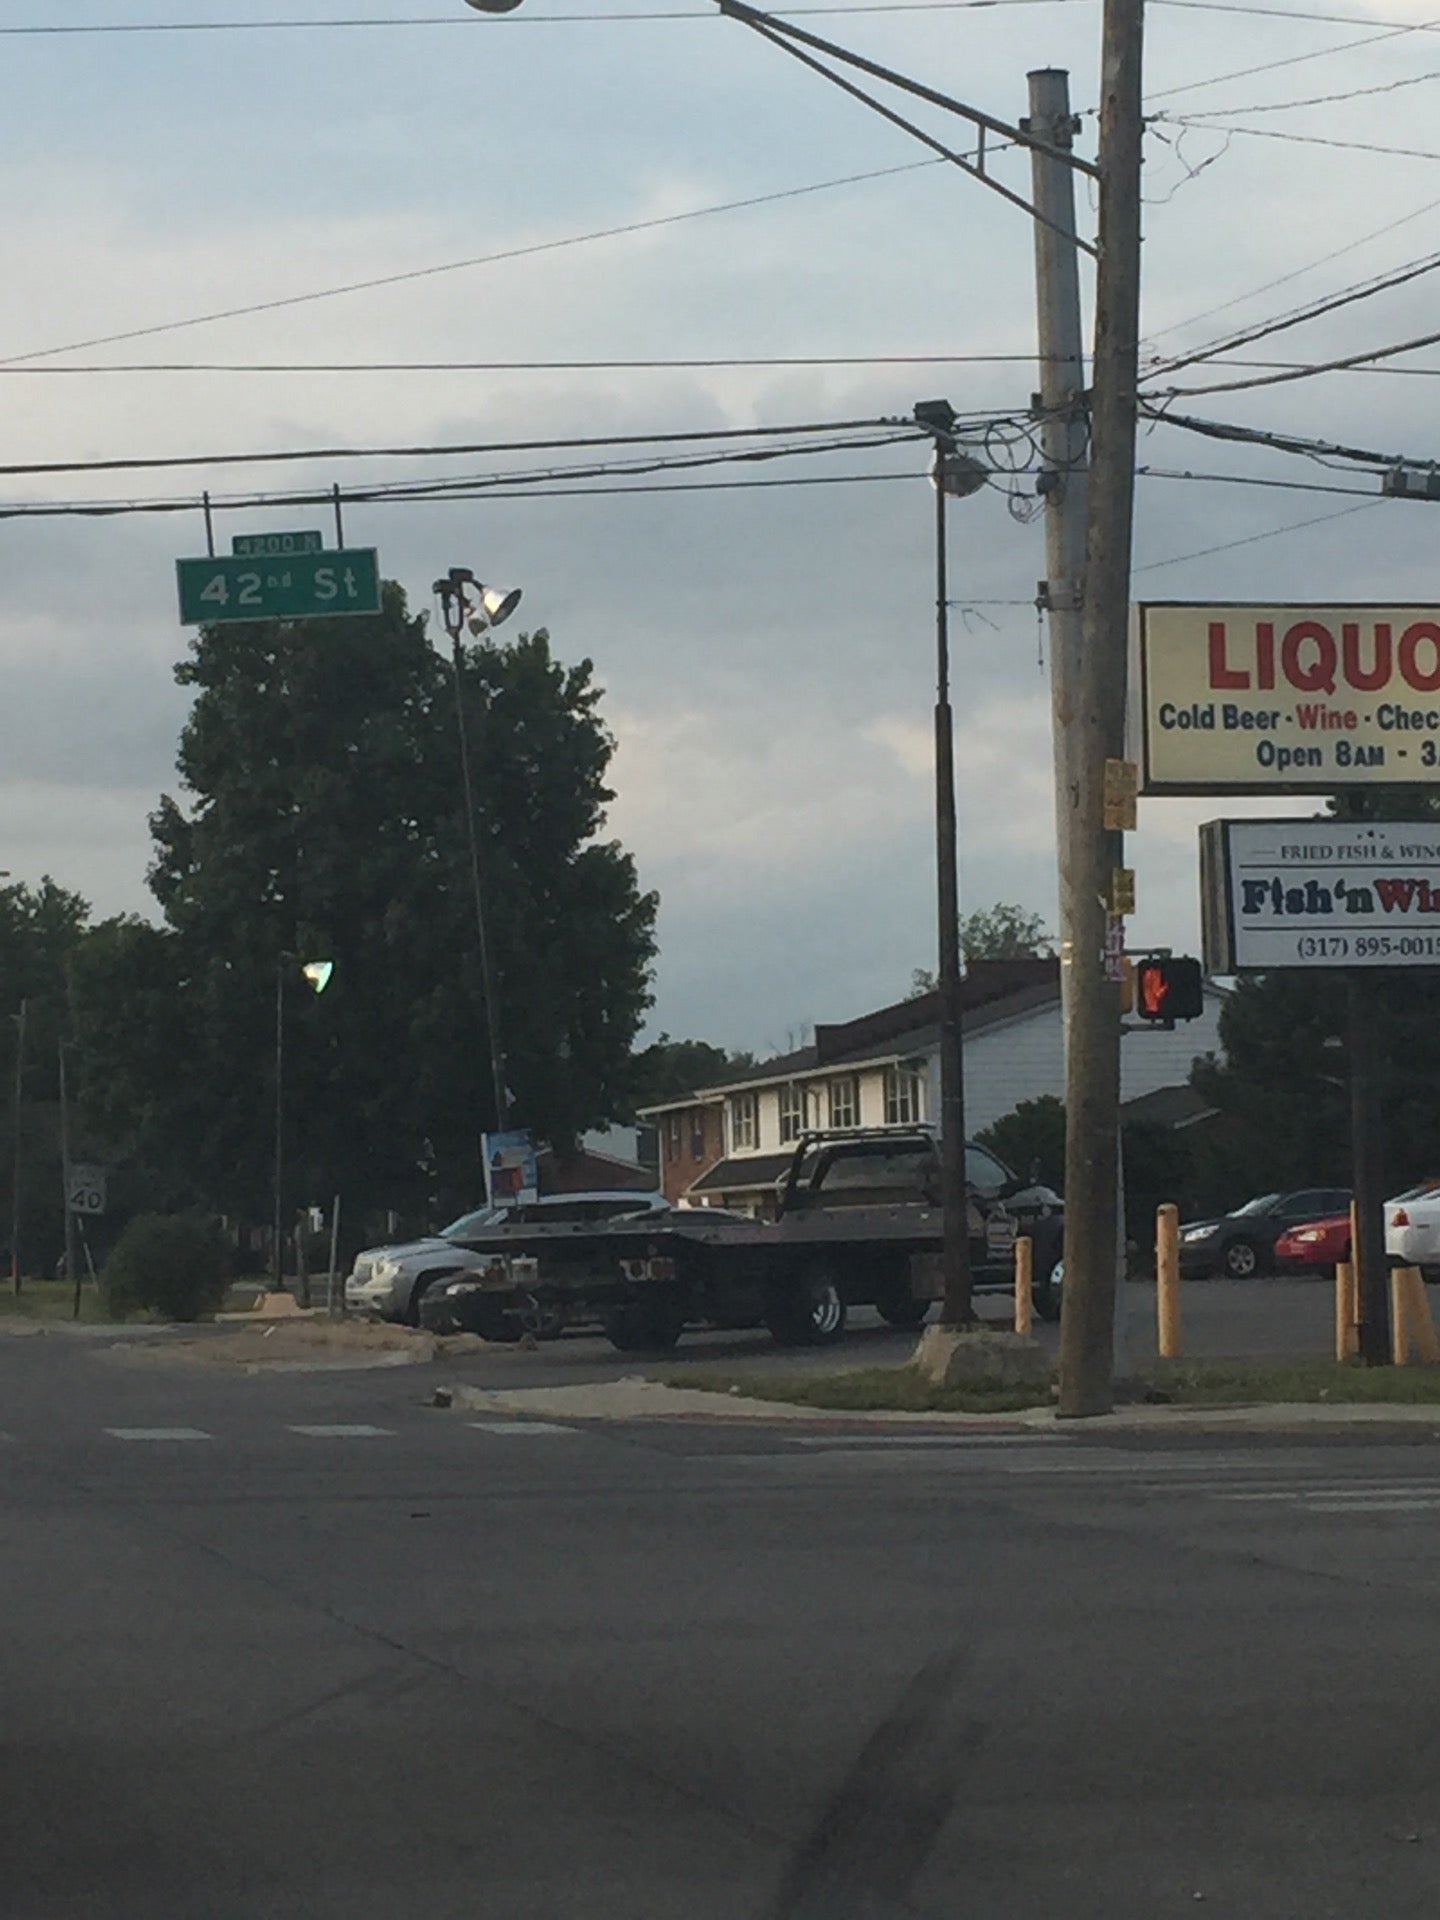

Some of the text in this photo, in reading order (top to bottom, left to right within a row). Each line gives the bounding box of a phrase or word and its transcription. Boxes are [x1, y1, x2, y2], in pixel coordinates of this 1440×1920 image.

[199, 566, 359, 606] 42nd St
[1207, 620, 1440, 696] LIQUO
[1159, 703, 1440, 731] Cold Beer Wine Chec
[1255, 739, 1322, 772] Open
[1335, 740, 1385, 768] 8AM
[1420, 740, 1440, 768] 3
[1281, 844, 1333, 860] FRIED
[1337, 844, 1376, 860] FISH
[1380, 844, 1394, 860] &
[1298, 937, 1349, 958] (317)
[71, 1188, 102, 1209] 40
